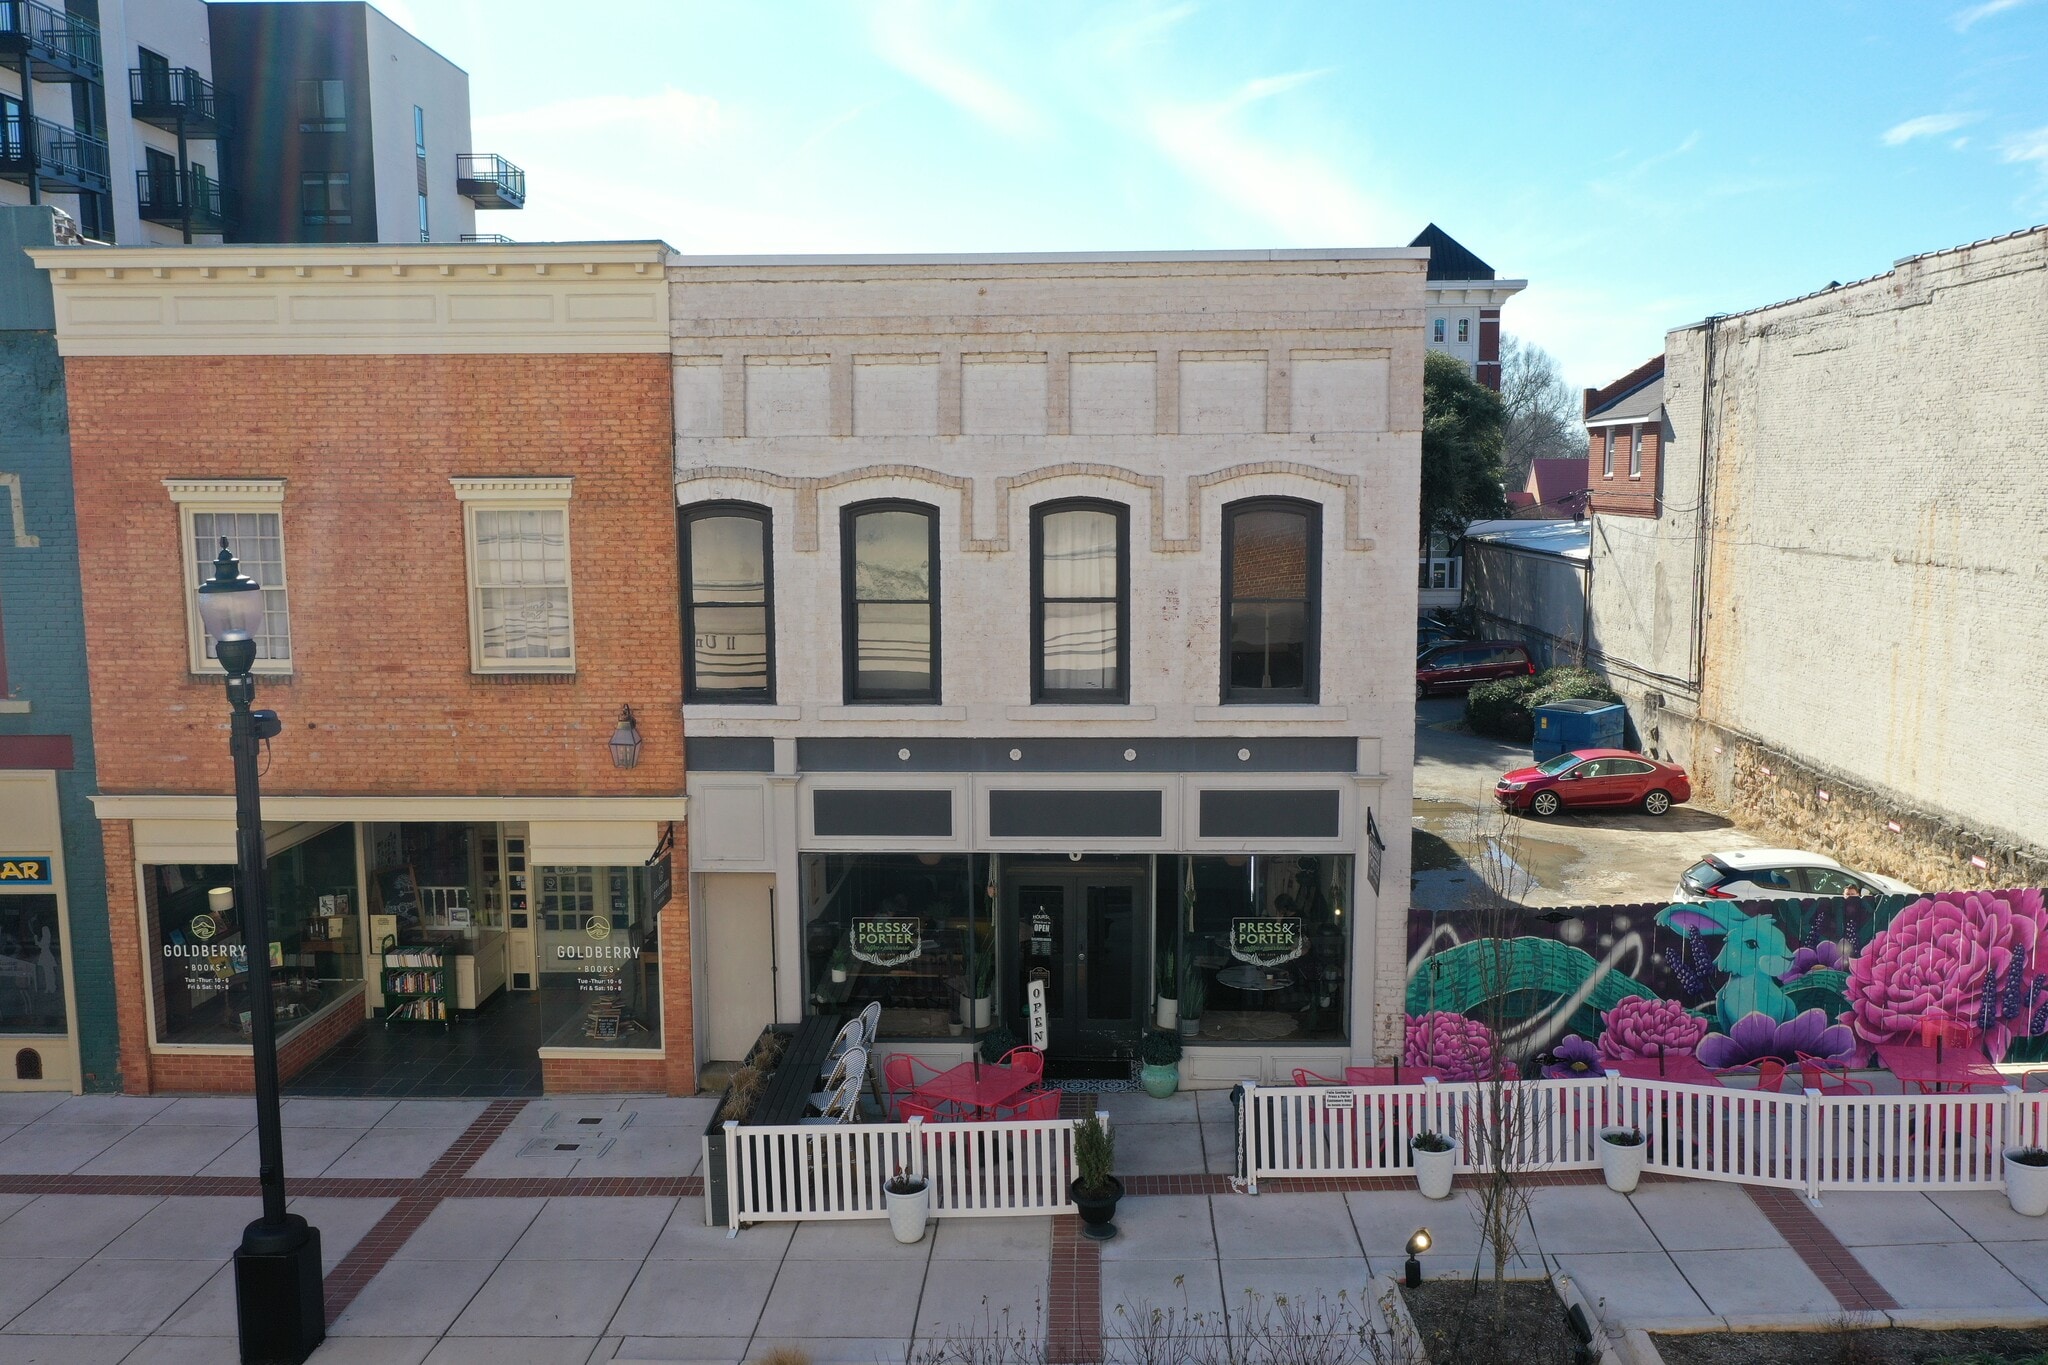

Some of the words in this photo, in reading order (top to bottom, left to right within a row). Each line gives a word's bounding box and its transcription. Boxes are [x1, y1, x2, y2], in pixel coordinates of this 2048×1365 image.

[0, 861, 39, 879] AR
[1033, 923, 1050, 932] OPEN
[859, 933, 914, 944] PORTER
[1239, 933, 1294, 944] PORTER
[163, 944, 246, 957] GOLDBERRY
[557, 946, 640, 959] GOLDBERRY
[584, 965, 614, 973] BOOKS
[1033, 988, 1044, 1043] OPEN
